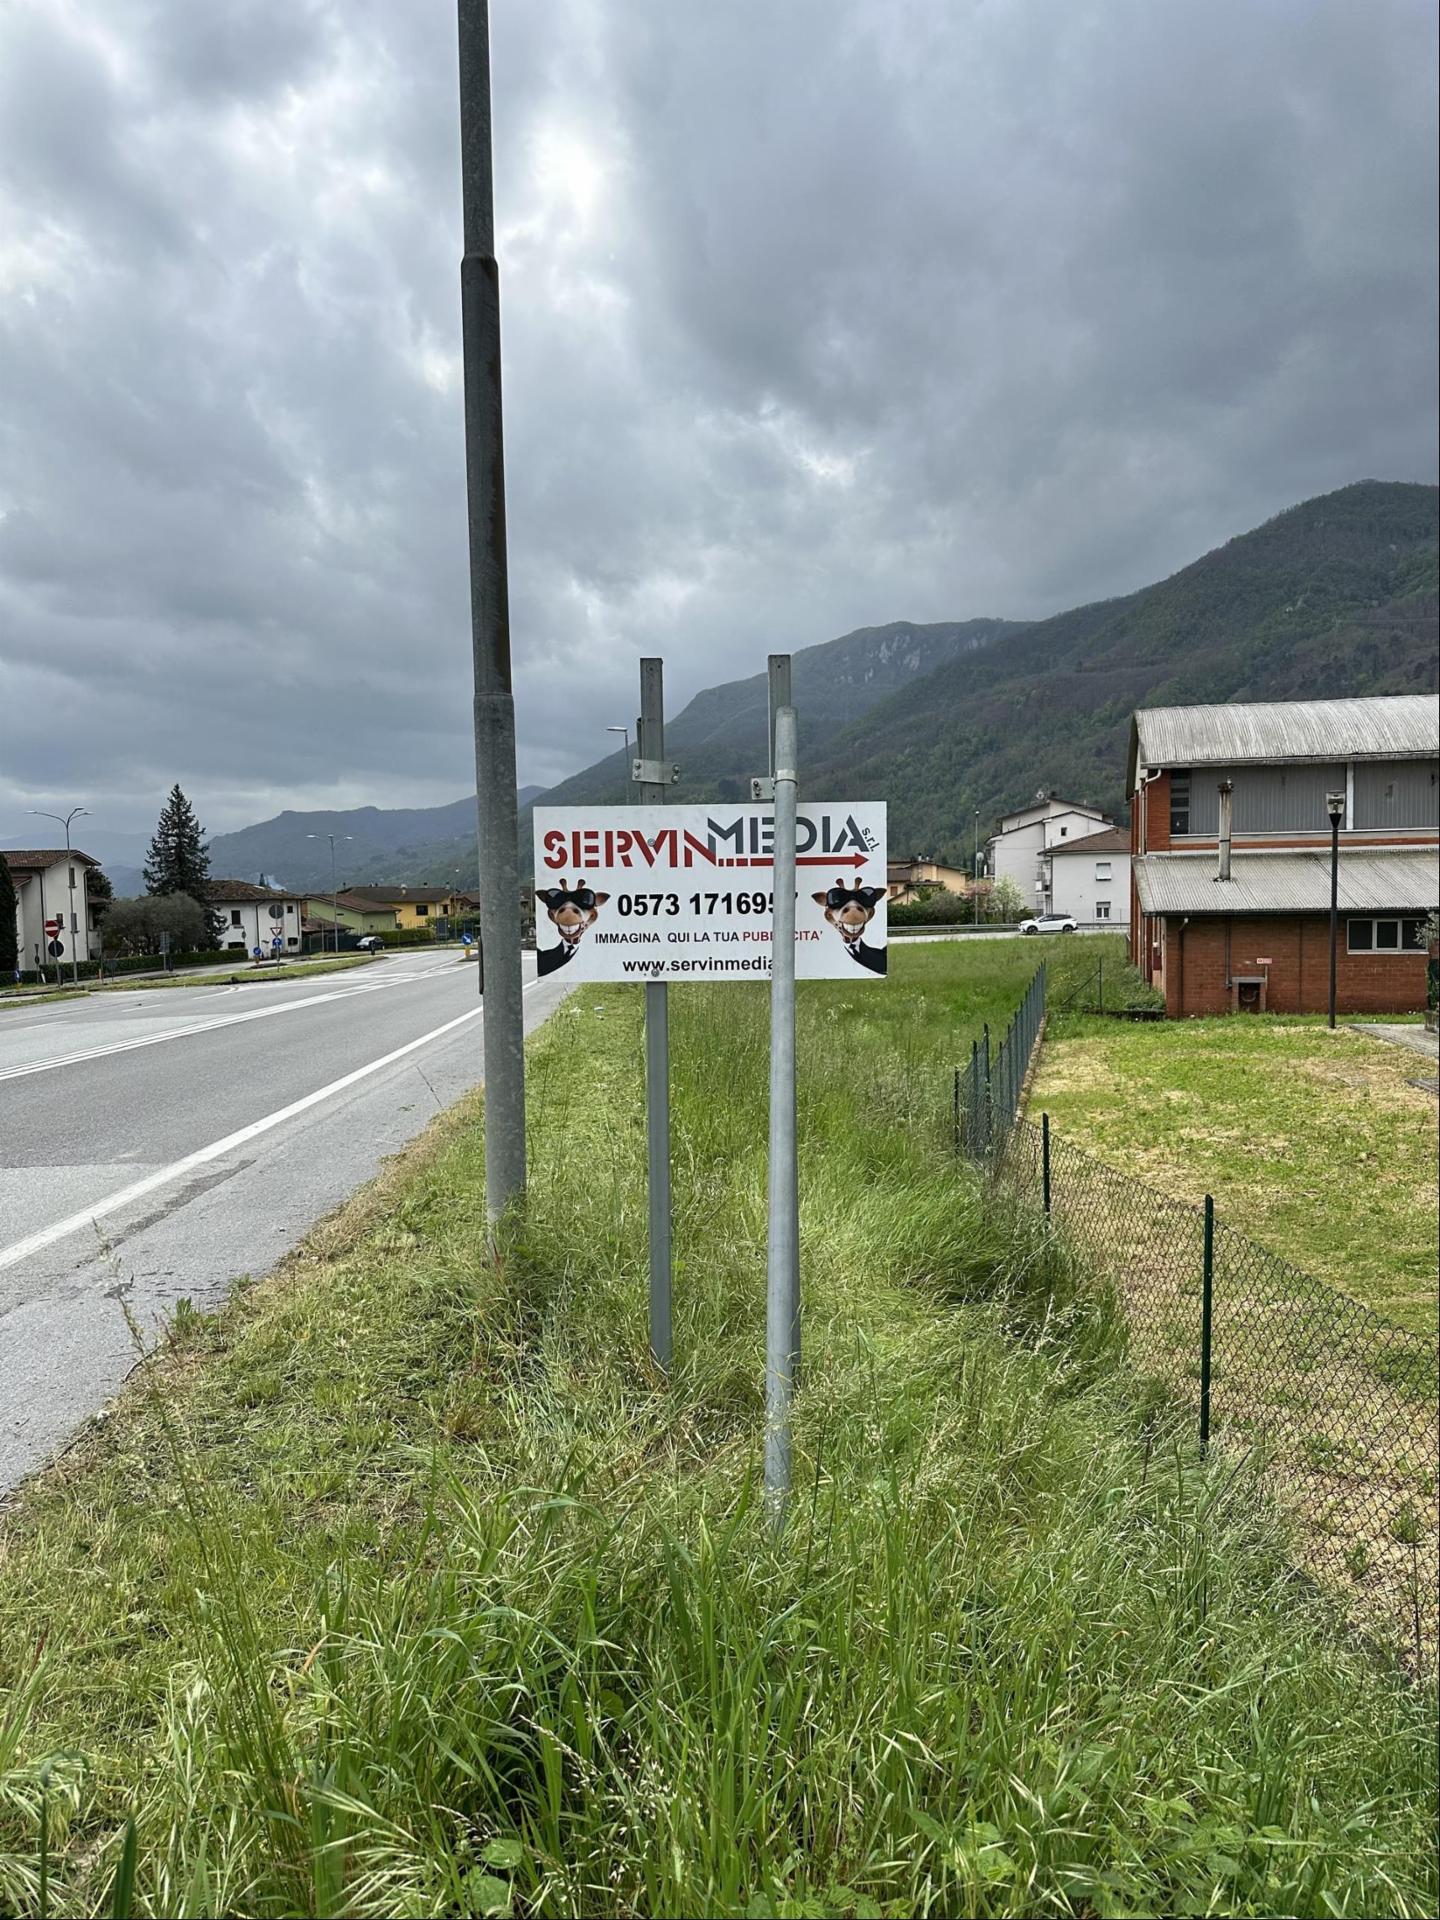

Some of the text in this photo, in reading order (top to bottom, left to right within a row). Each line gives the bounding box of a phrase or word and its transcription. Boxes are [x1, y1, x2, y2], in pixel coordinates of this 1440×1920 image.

[617, 892, 799, 916] 0573 17169
[595, 933, 660, 944] IMMAGINA
[667, 932, 690, 943] QUI
[694, 932, 710, 942] LA
[713, 931, 739, 942] TUA
